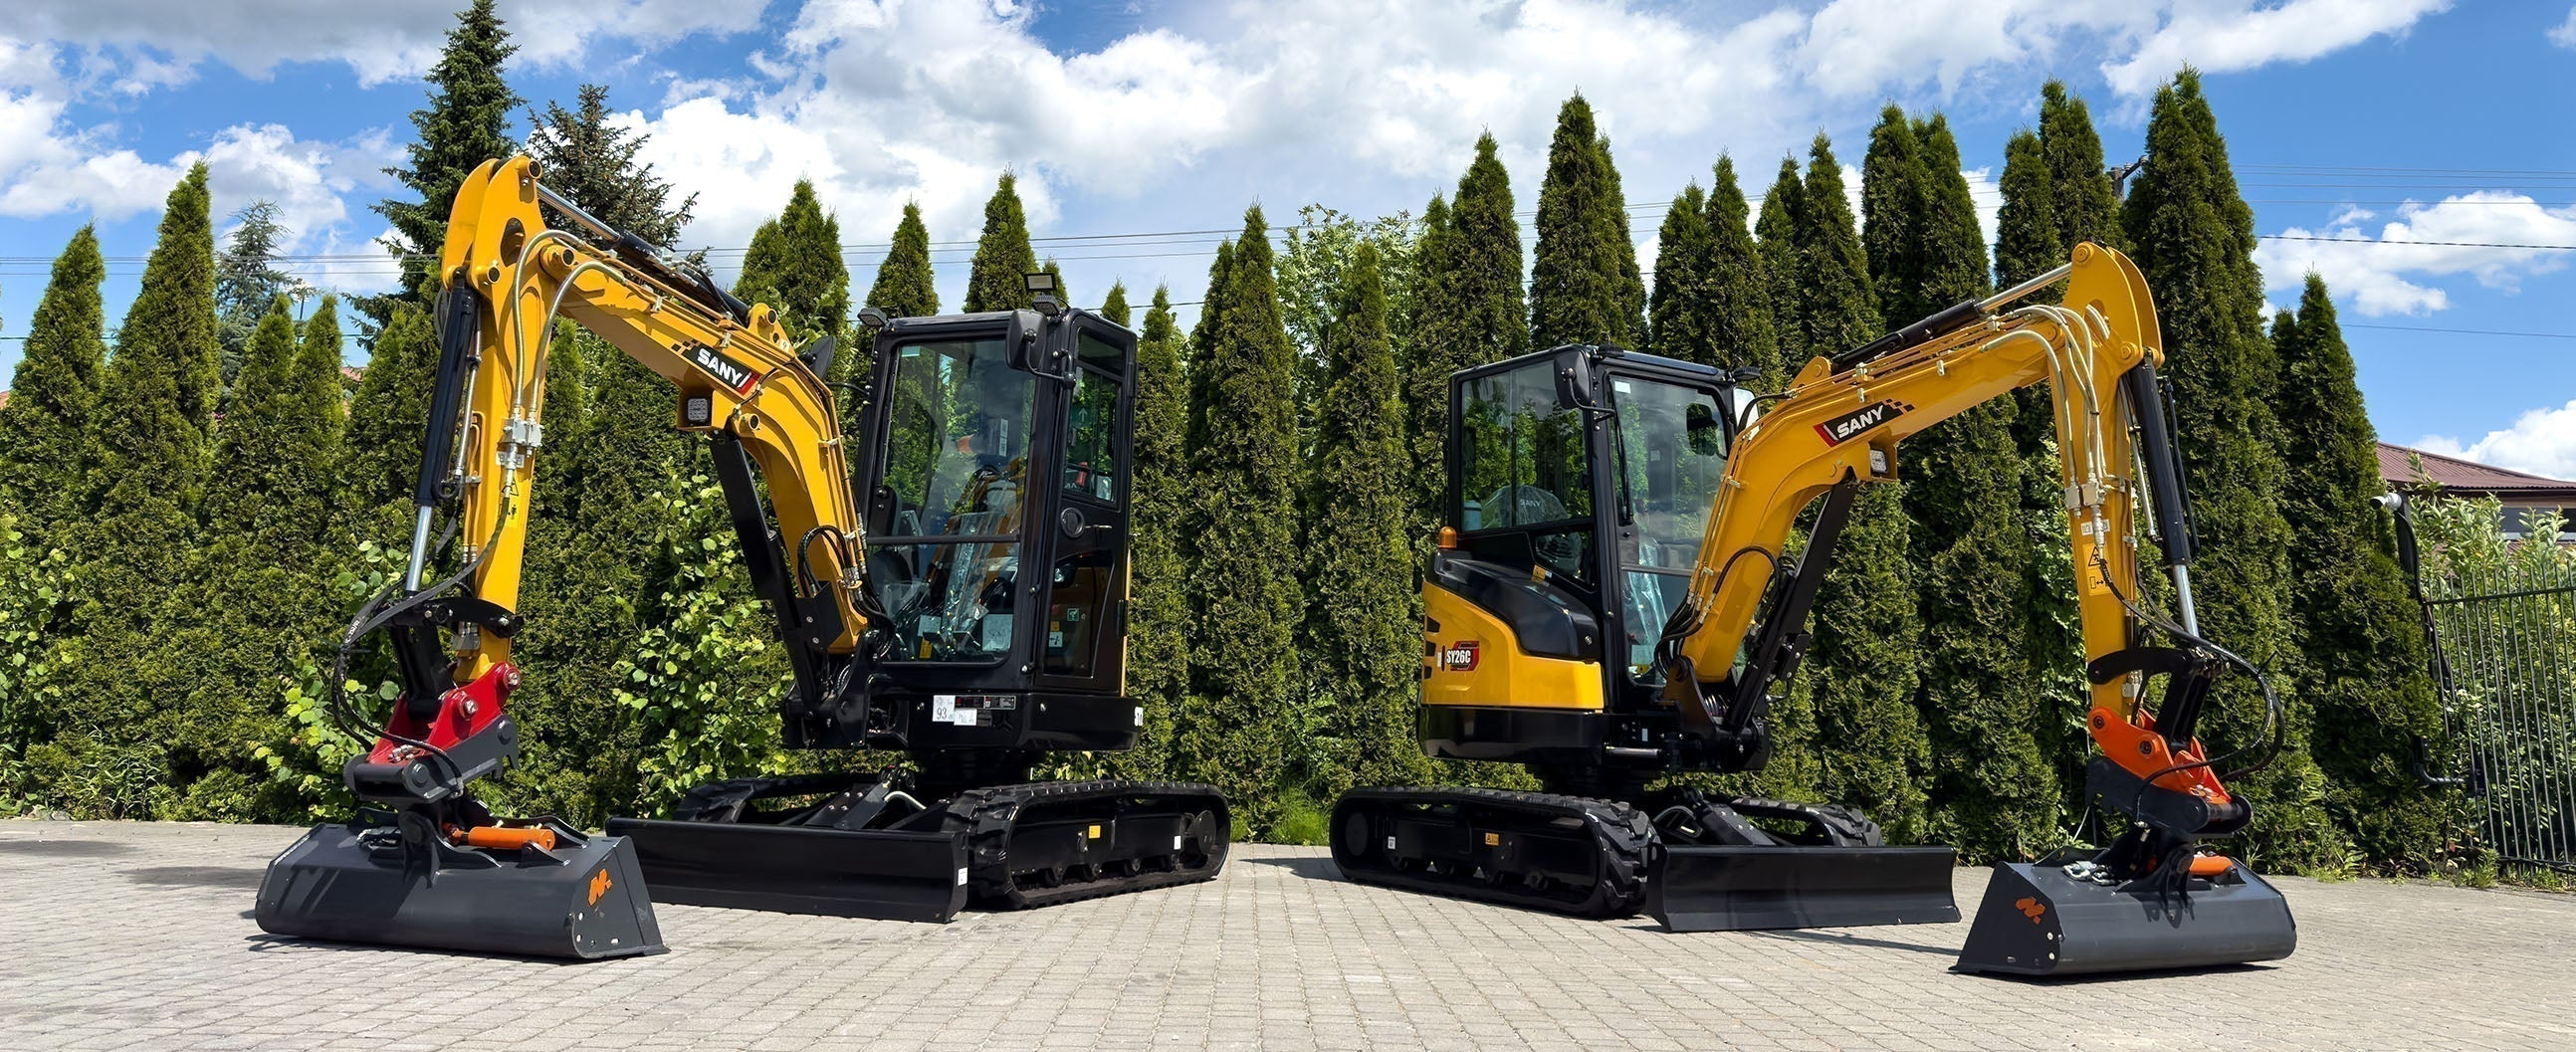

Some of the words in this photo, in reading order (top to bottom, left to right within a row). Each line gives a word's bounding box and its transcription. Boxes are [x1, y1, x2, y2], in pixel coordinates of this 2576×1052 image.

[697, 347, 743, 385] SANY
[1836, 404, 1884, 438] SANY
[1446, 649, 1471, 664] SY26C
[937, 708, 947, 720] 93
